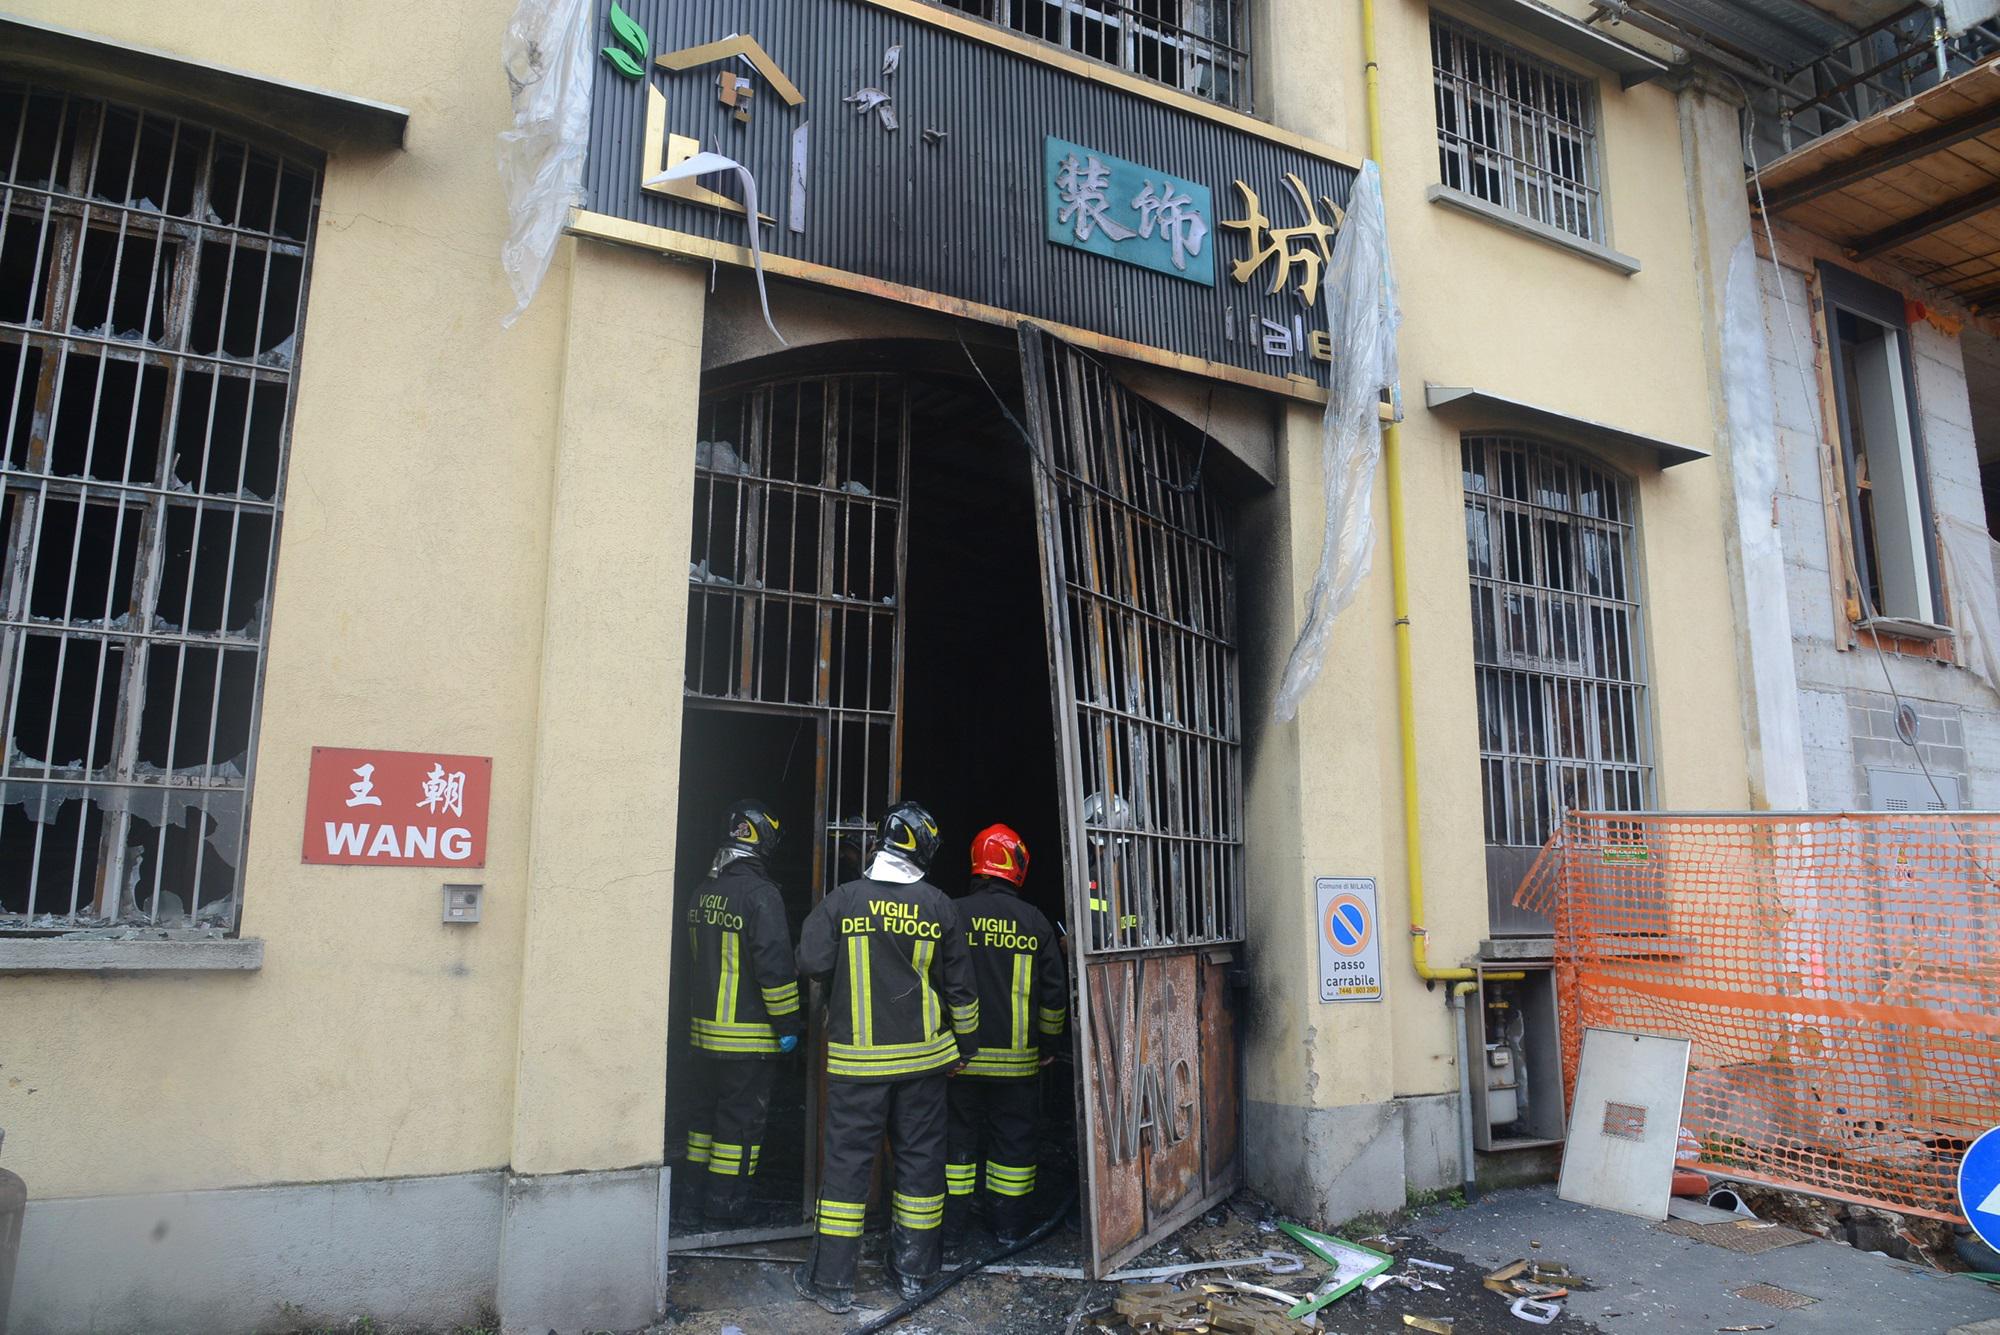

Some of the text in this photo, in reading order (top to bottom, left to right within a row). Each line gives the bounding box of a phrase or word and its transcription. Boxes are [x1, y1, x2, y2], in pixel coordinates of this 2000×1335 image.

[345, 763, 466, 818] 王朝
[324, 822, 472, 860] WANG
[868, 900, 919, 919] VIGILI
[842, 917, 876, 934] DEL
[971, 917, 1017, 934] VIGILI
[985, 933, 1038, 951] FUOCO
[1334, 961, 1365, 972] passo
[1326, 974, 1375, 987] carrabile
